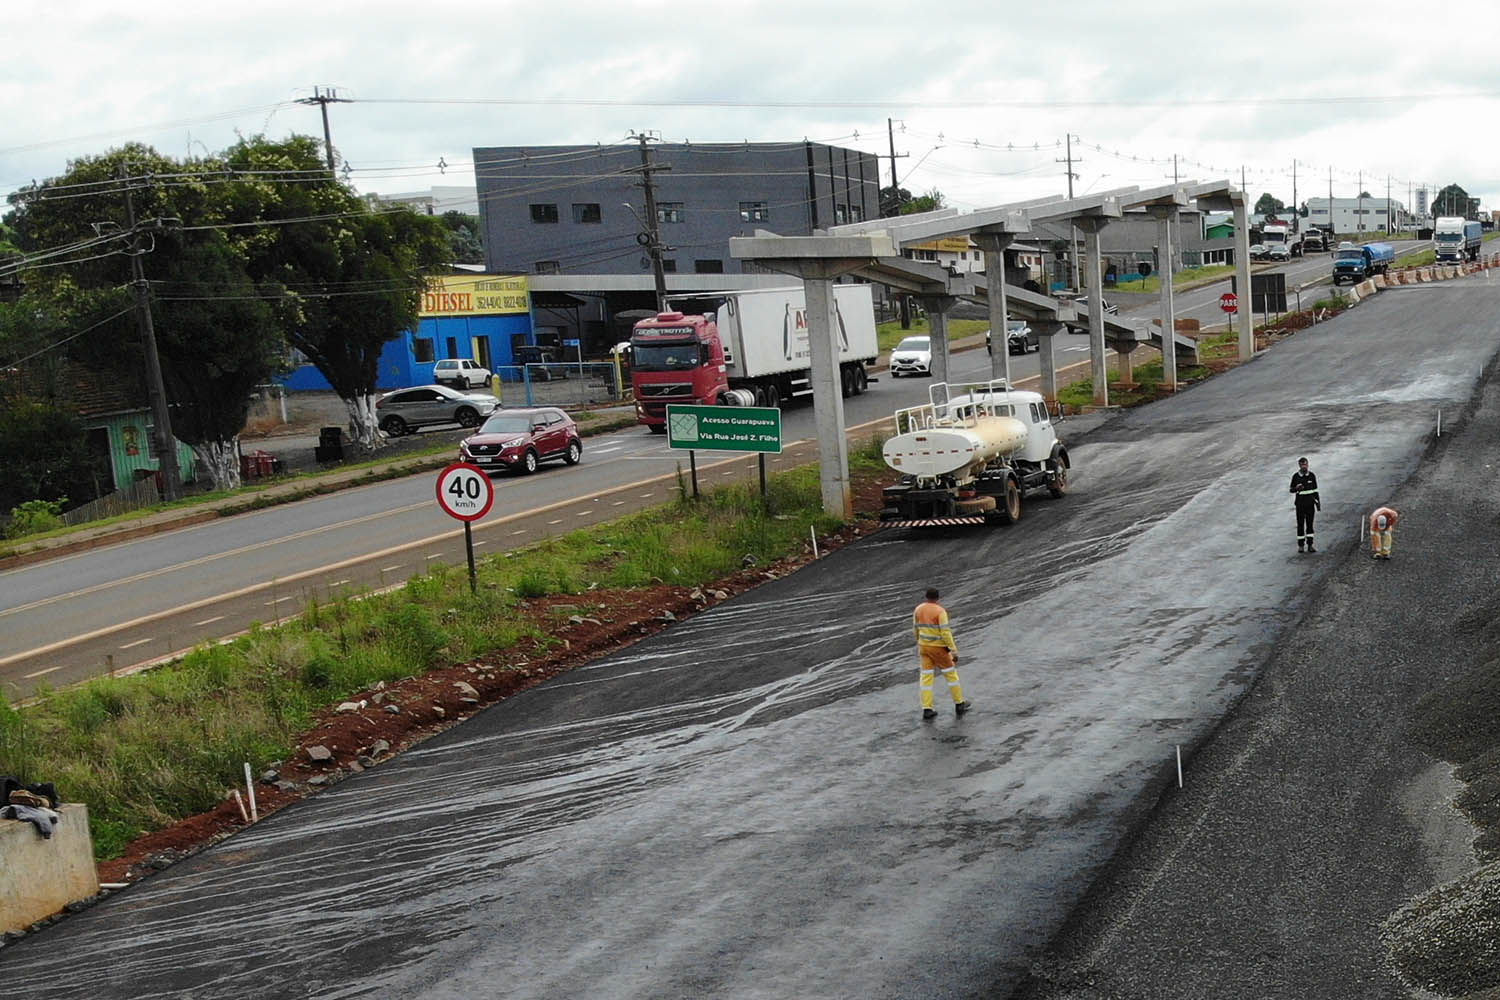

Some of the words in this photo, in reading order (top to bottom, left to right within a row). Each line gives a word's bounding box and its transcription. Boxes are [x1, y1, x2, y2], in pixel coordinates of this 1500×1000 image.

[425, 293, 473, 312] DIESEL
[1220, 299, 1237, 307] PARE
[702, 417, 730, 425] Acesso
[731, 418, 775, 426] Guarapuava
[731, 433, 748, 441] José
[760, 434, 778, 442] Filho
[449, 476, 480, 499] 40
